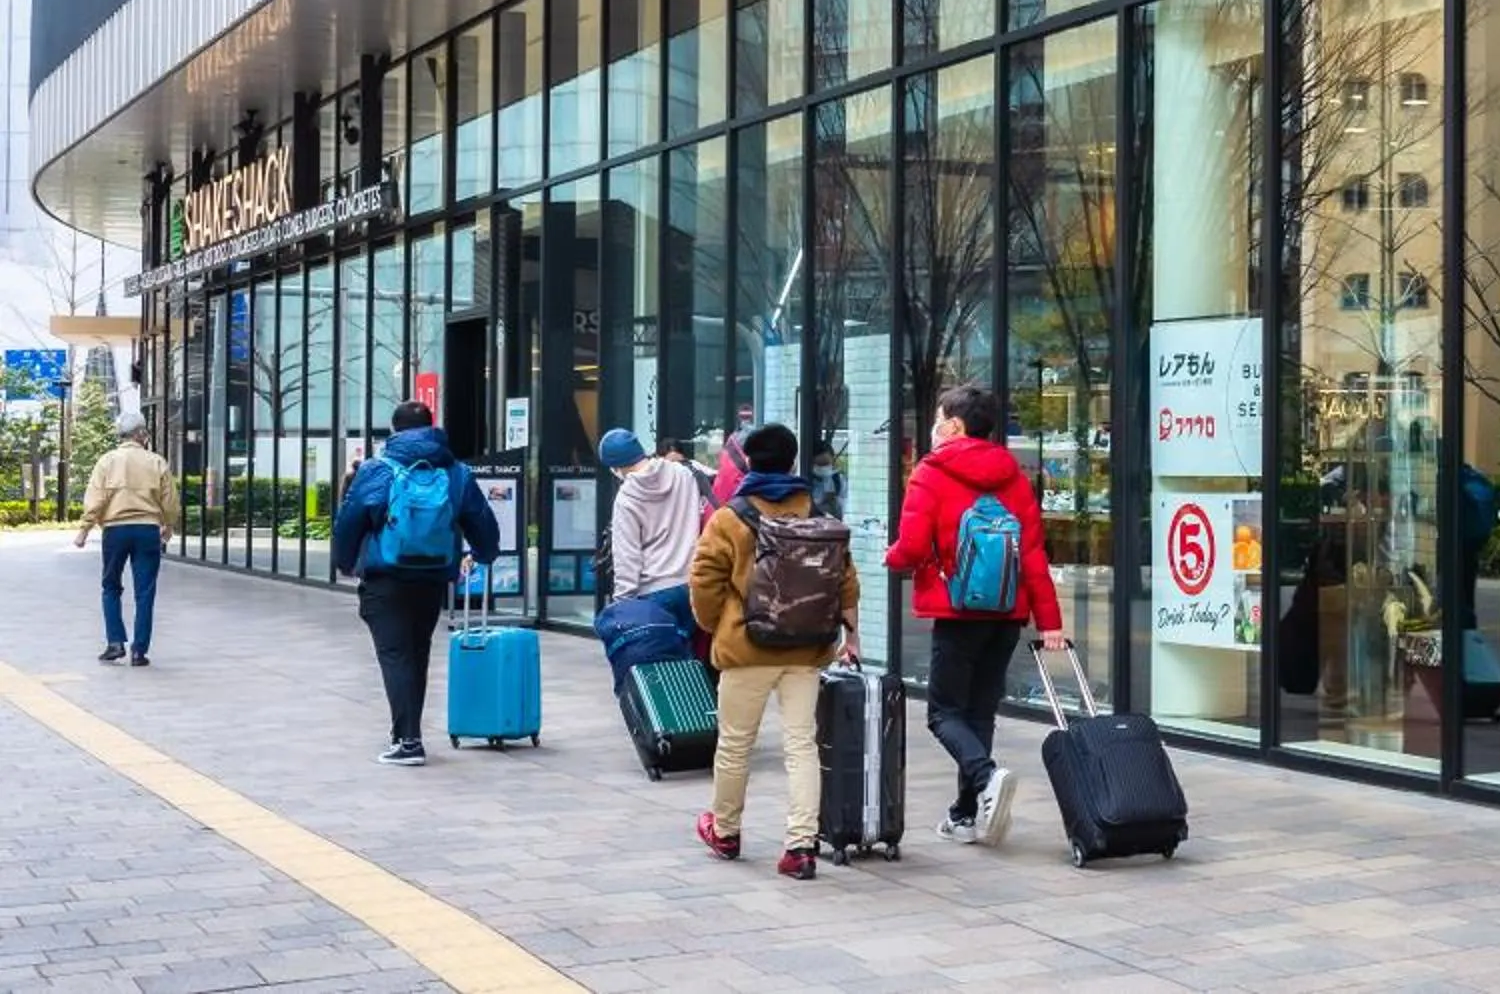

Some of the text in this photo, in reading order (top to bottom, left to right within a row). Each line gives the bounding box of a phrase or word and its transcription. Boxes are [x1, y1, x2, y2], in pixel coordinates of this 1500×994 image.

[184, 145, 291, 253] SHAKE SHACK
[1159, 351, 1216, 377] レアもん
[1238, 401, 1262, 417] SE
